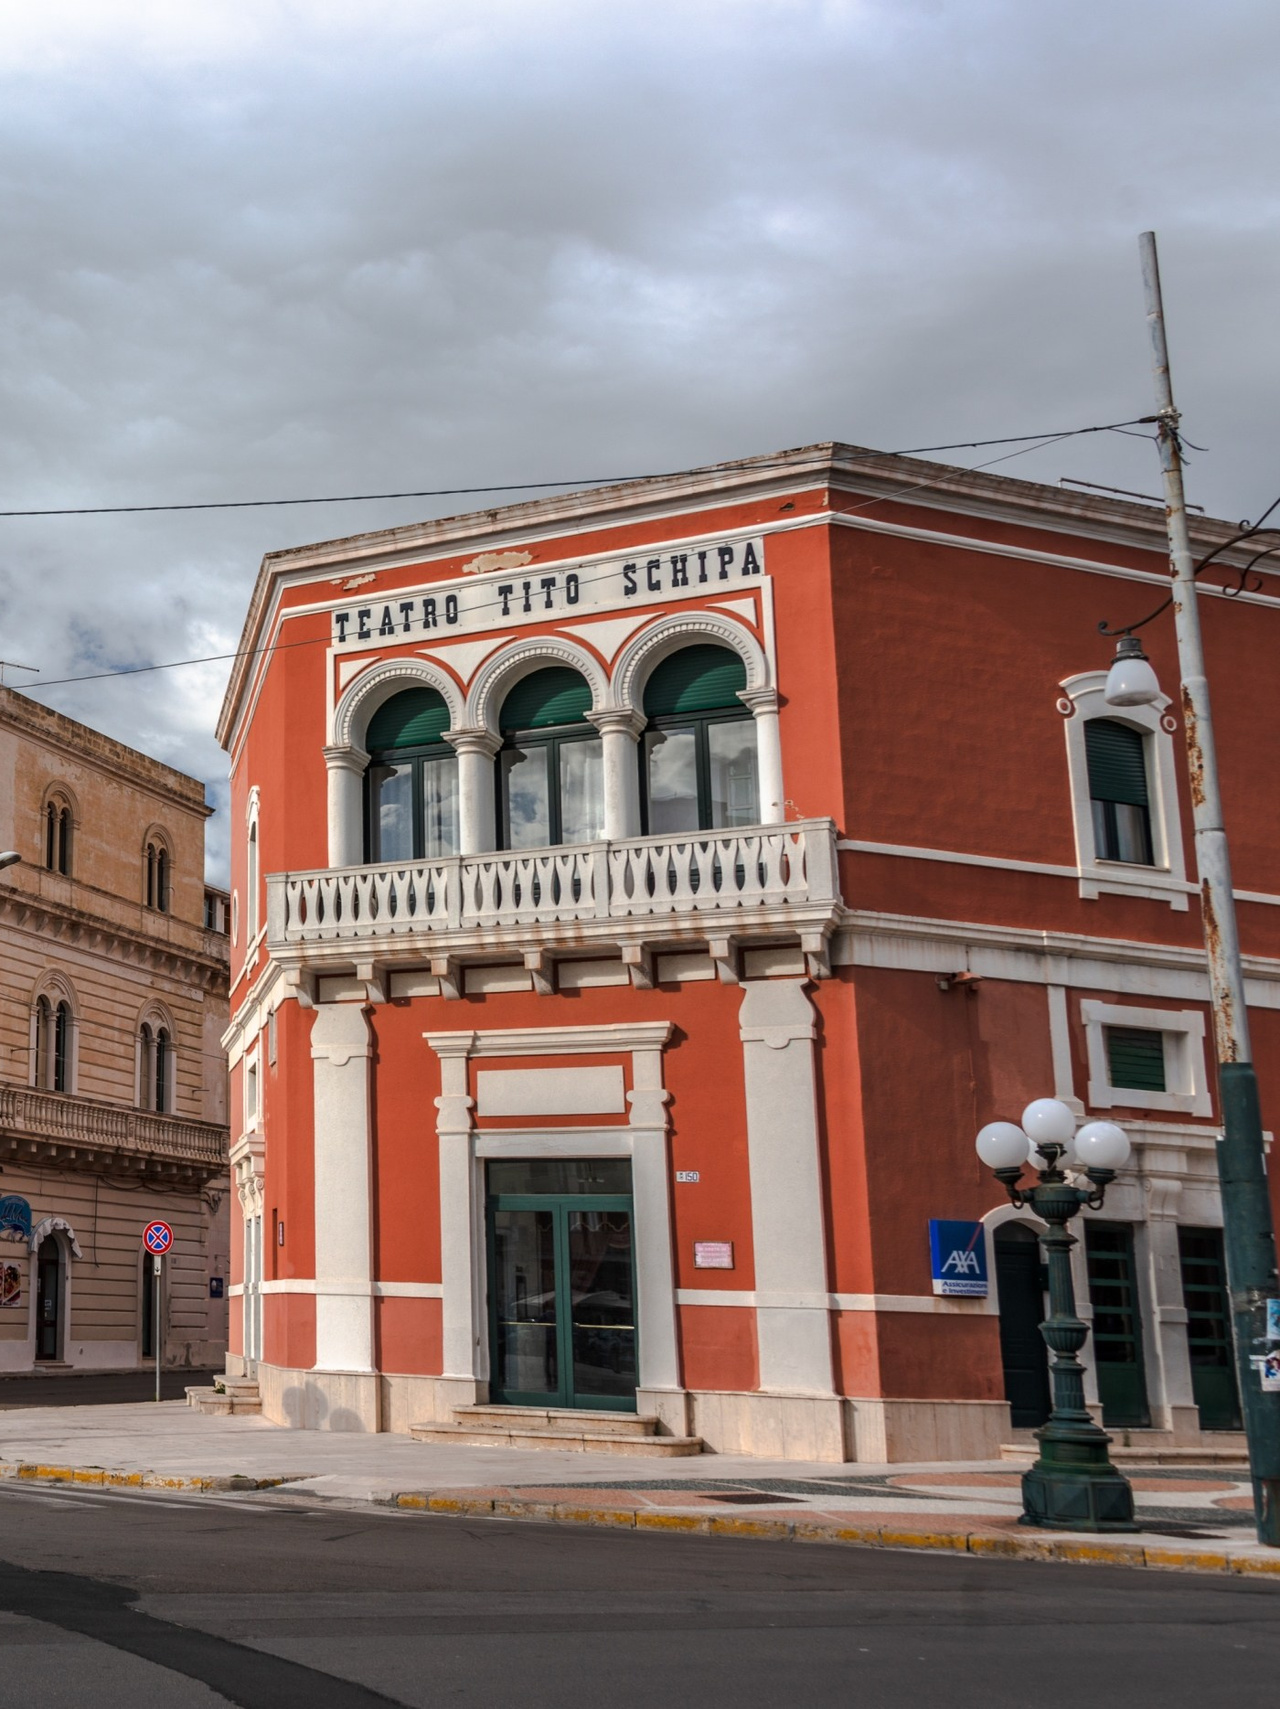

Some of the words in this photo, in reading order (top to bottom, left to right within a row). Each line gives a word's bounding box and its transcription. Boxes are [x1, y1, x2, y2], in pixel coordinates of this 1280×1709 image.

[335, 594, 458, 643] TEATRO
[498, 573, 579, 616] TITO
[623, 541, 761, 596] SCHIPA
[941, 1250, 980, 1274] AXA
